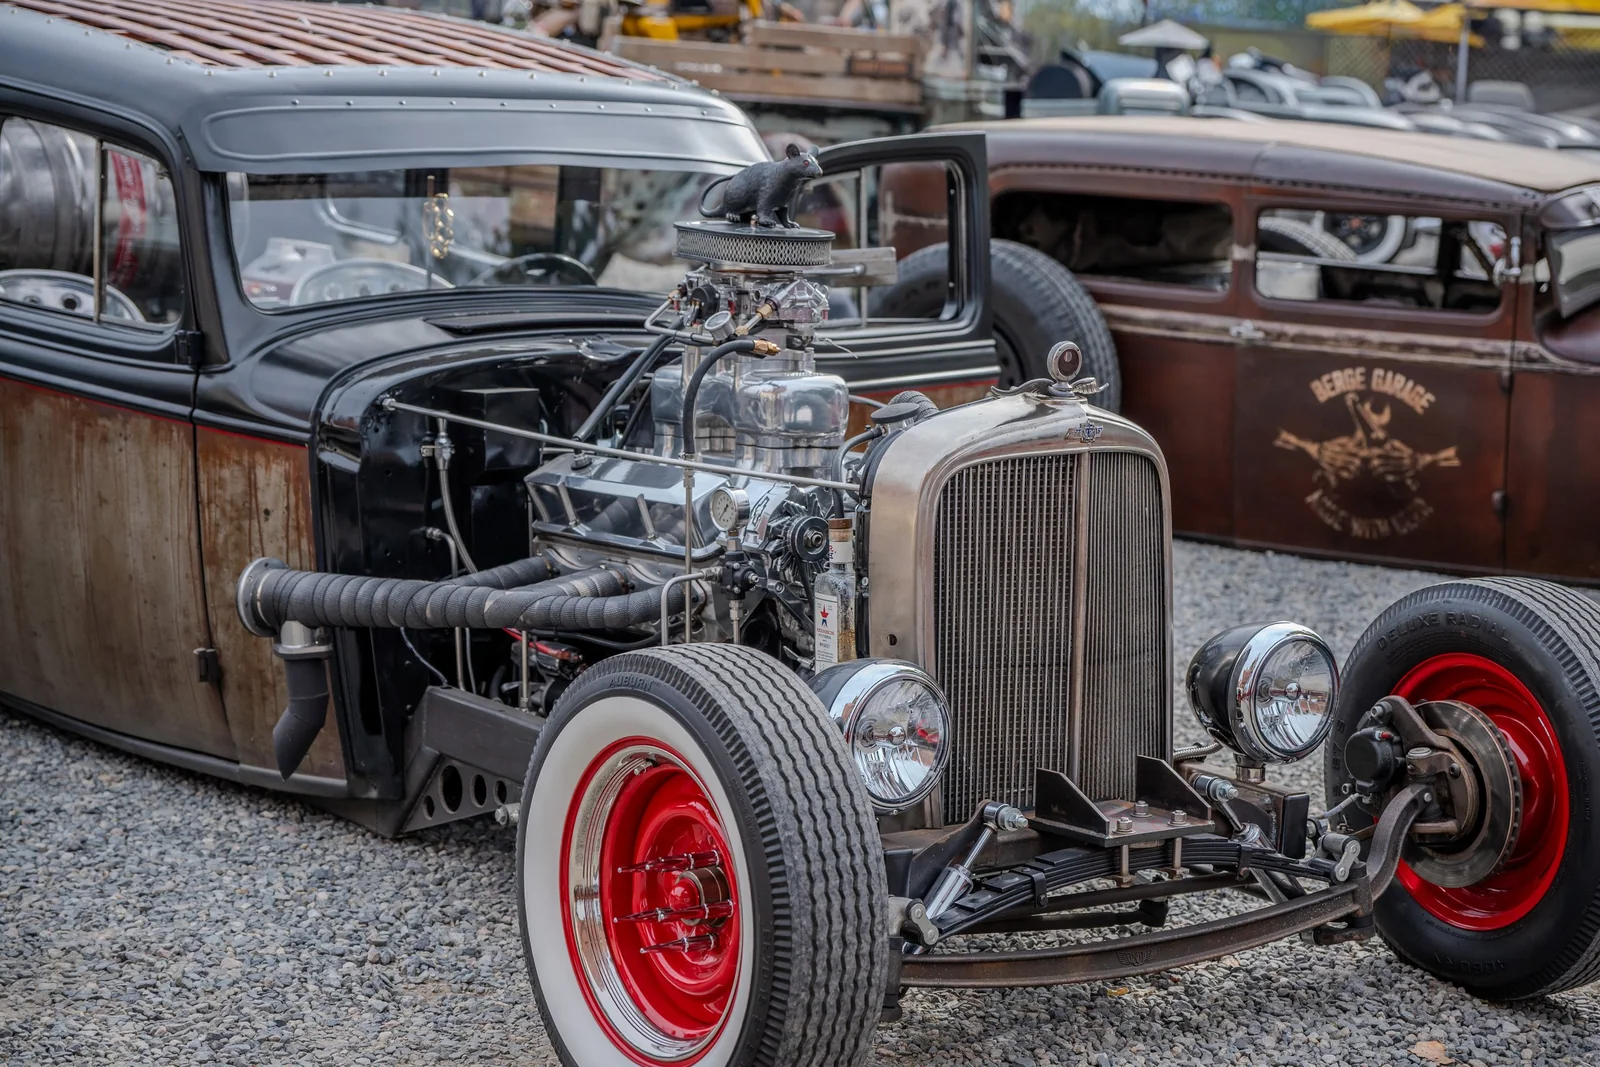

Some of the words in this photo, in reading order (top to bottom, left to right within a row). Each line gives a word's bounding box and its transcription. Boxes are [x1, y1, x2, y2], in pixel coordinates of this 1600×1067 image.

[1370, 367, 1437, 416] GARAGE
[1377, 611, 1440, 650] DELUXE
[1446, 611, 1510, 643] RADIAL
[608, 674, 653, 692] AUBURN
